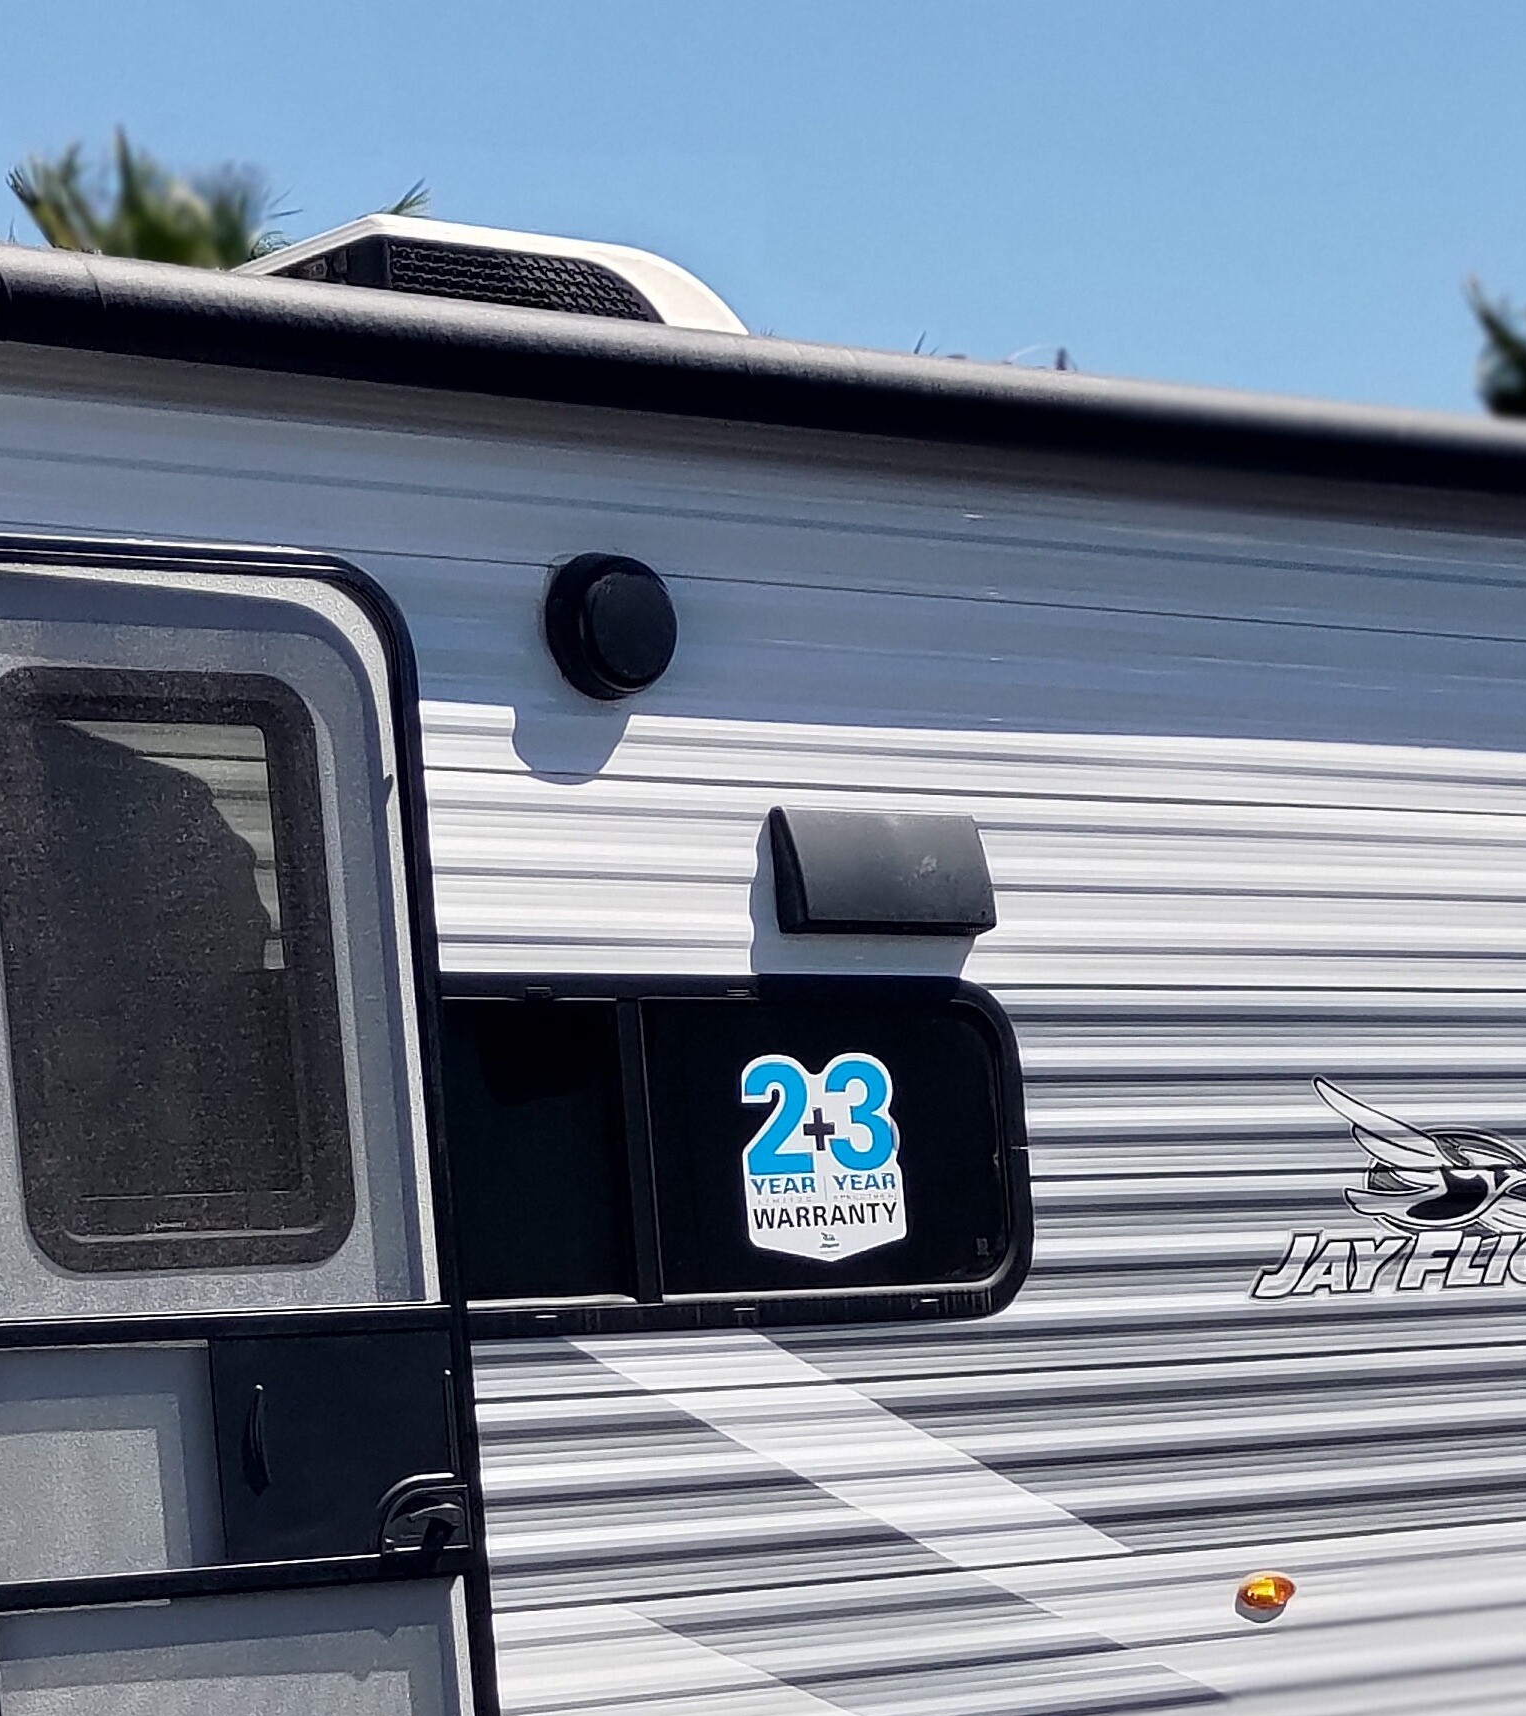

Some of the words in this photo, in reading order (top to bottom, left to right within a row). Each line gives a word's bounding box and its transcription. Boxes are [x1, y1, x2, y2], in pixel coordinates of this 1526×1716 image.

[750, 1176, 816, 1195] YEAR
[832, 1172, 896, 1191] YEAR
[752, 1201, 898, 1230] WARRANTY
